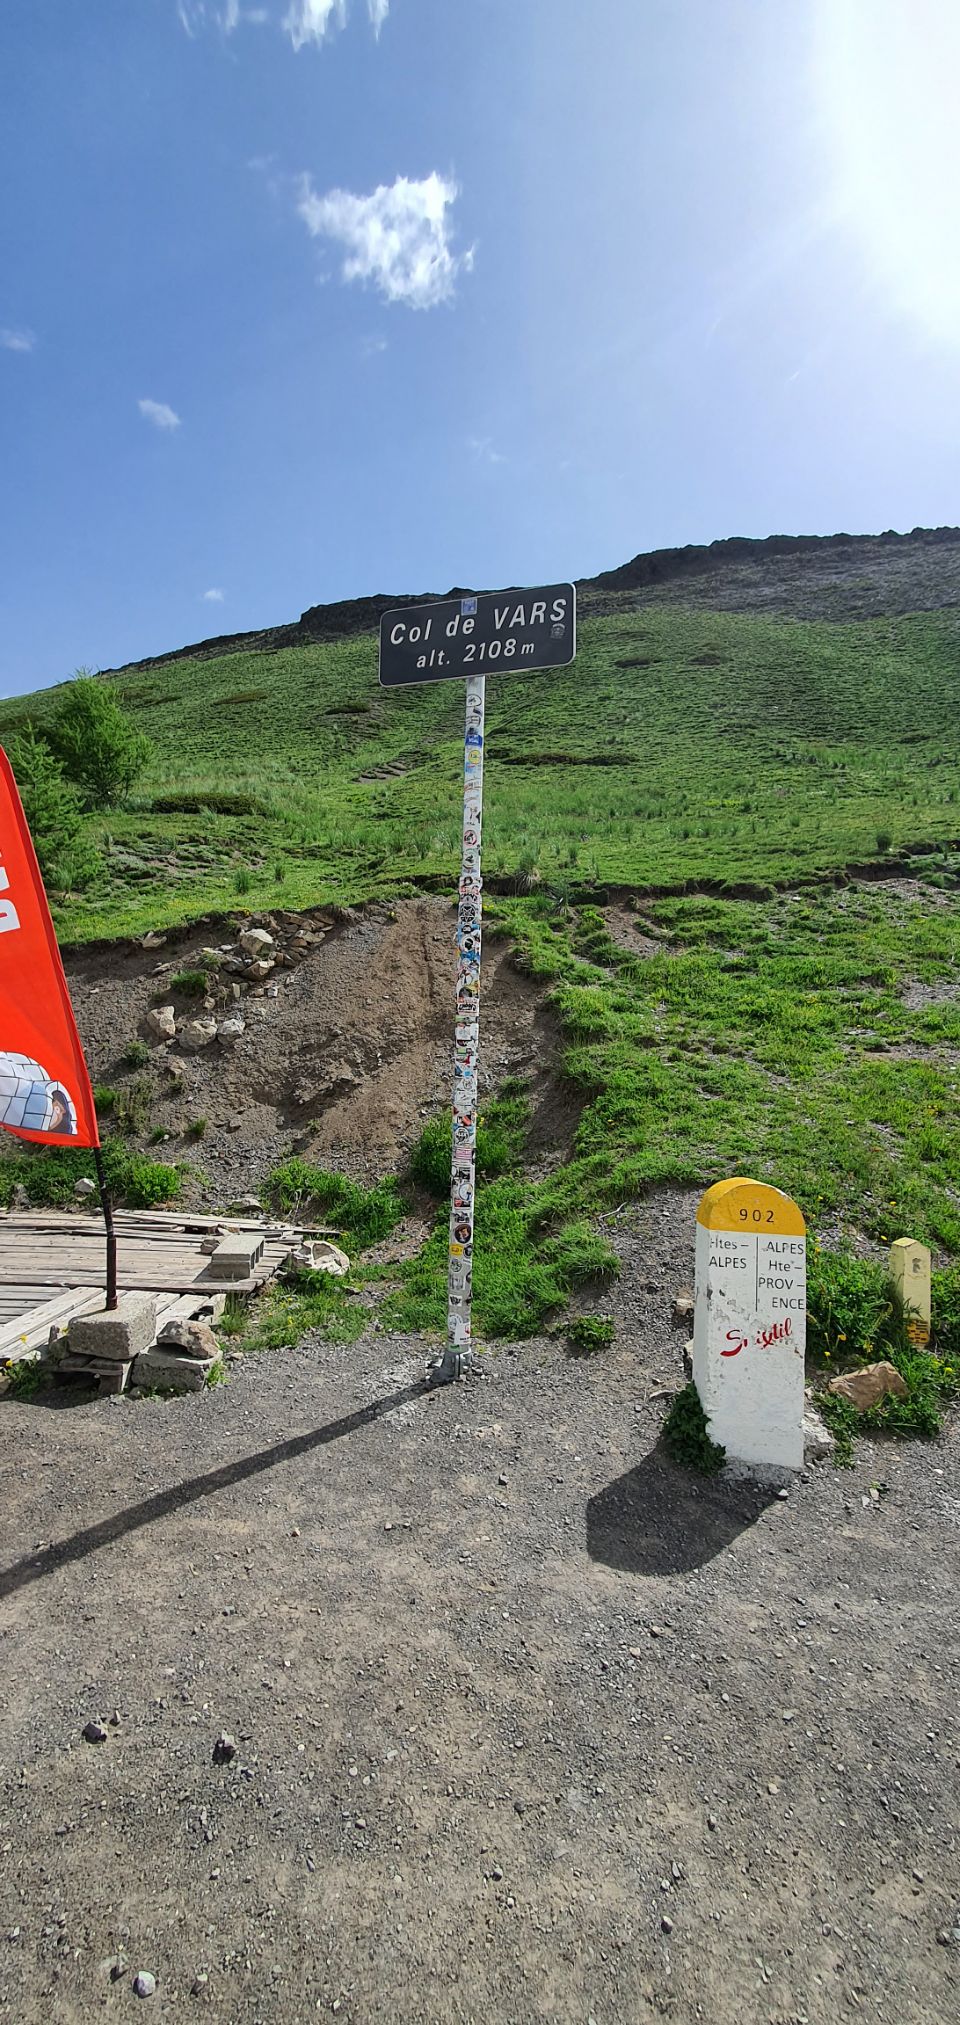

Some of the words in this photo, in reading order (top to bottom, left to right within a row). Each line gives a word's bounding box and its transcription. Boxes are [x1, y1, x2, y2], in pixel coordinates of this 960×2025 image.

[390, 619, 433, 645] Col
[445, 614, 475, 637] de
[494, 598, 567, 631] VARS
[416, 649, 451, 669] alt.
[462, 638, 517, 663] 2108
[520, 642, 535, 655] m
[767, 1241, 805, 1255] ALPES
[708, 1255, 747, 1269] ALPES
[771, 1296, 805, 1310] ENCE
